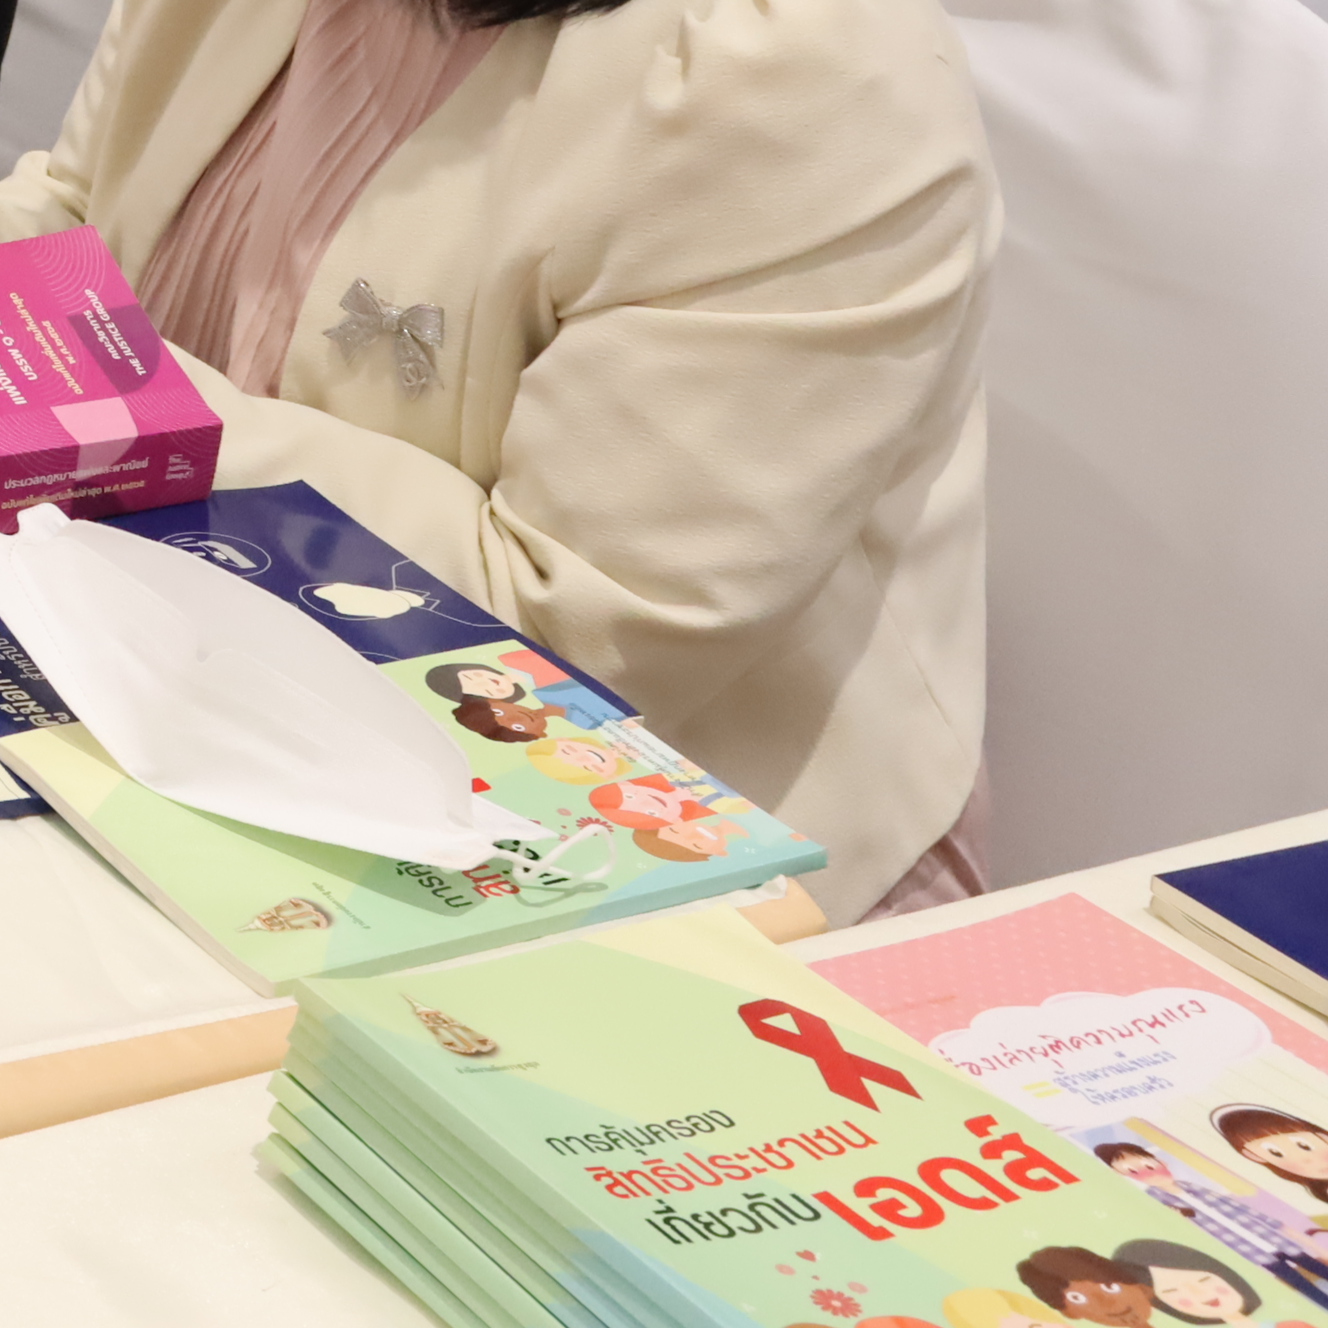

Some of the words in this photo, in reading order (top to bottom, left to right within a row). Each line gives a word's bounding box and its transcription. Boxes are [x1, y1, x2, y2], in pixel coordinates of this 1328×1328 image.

[84, 288, 111, 322] GROUP
[83, 309, 122, 360] คณะวิชาการ
[105, 321, 135, 357] JUSTICE
[7, 348, 38, 381] บรรพ
[128, 356, 147, 376] THE
[544, 1109, 737, 1157] การคุ้มครอง
[583, 1120, 880, 1200] สิทธิประชาชน
[644, 1190, 823, 1246] เกี่ยวกับ
[811, 1112, 1082, 1242] เอดส์
